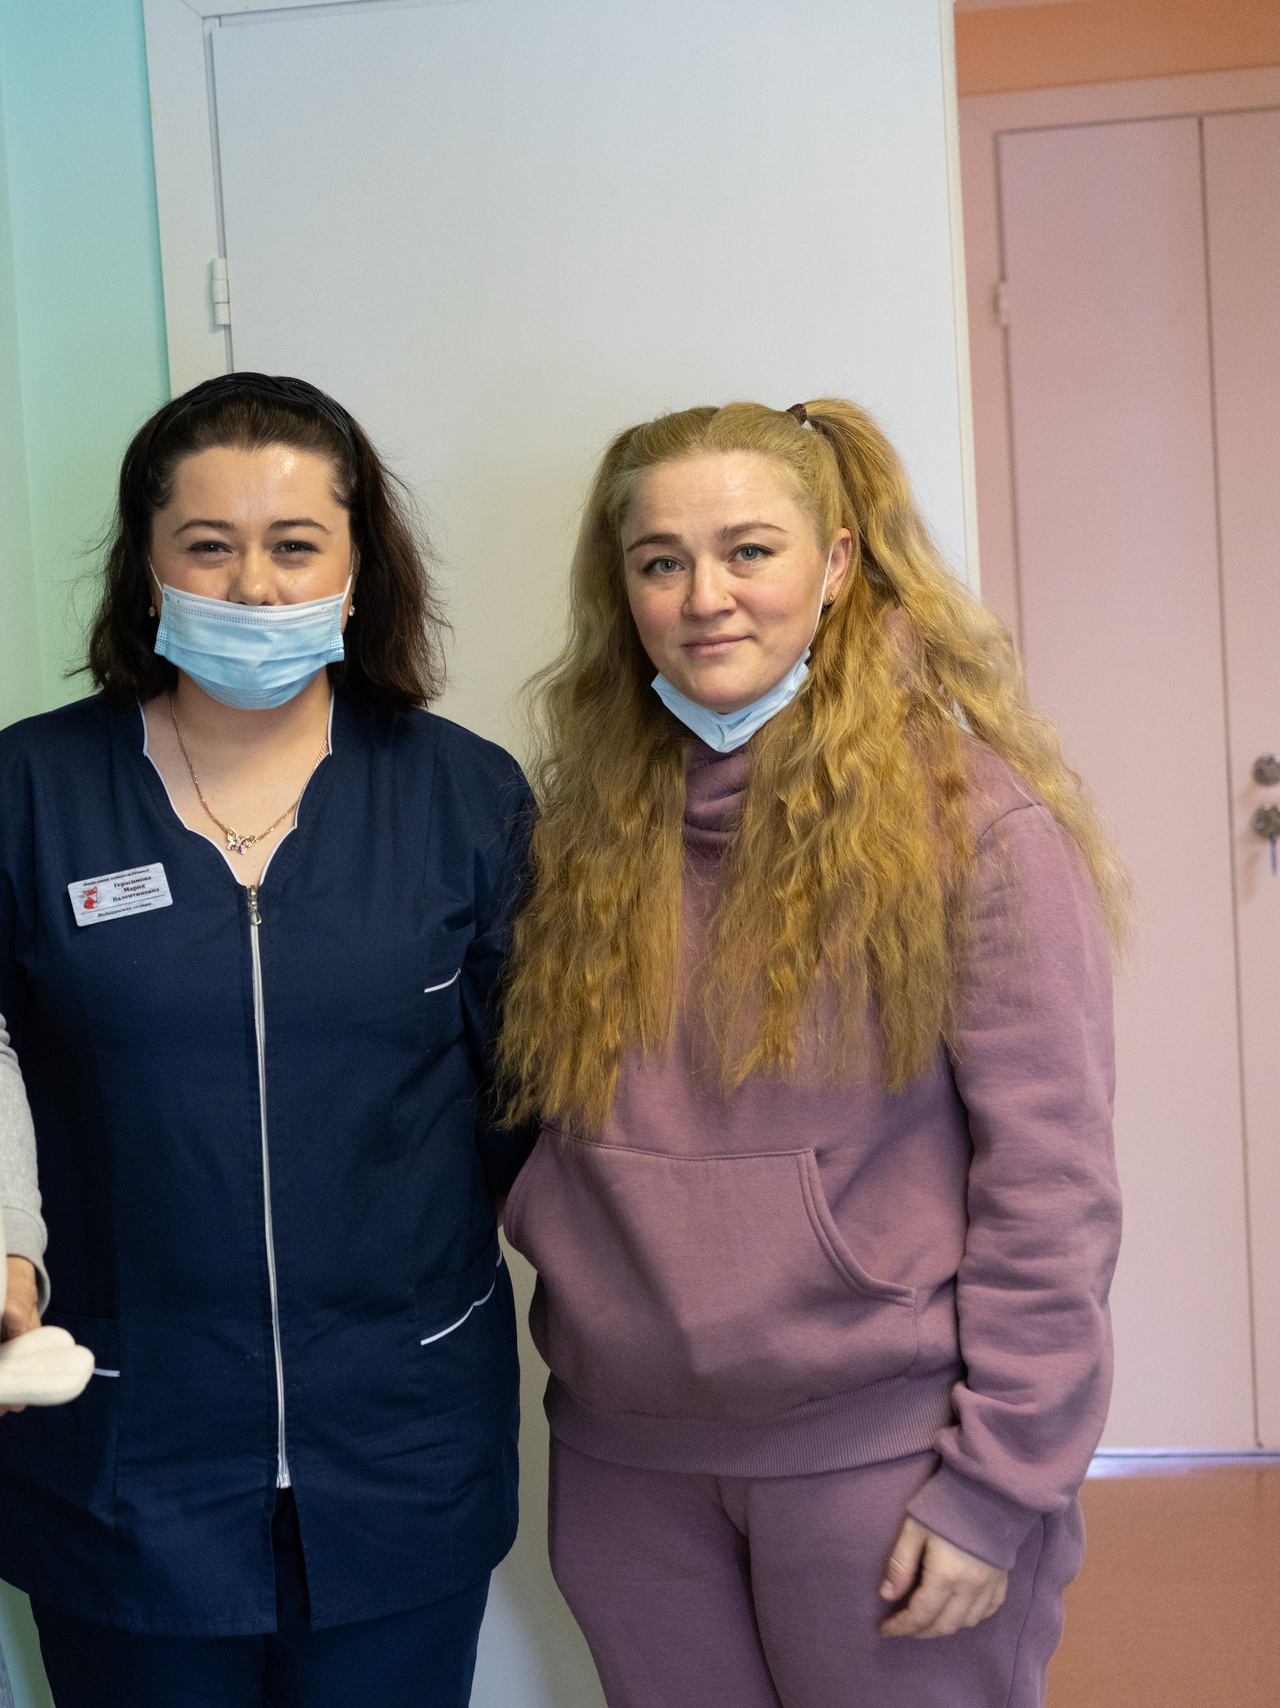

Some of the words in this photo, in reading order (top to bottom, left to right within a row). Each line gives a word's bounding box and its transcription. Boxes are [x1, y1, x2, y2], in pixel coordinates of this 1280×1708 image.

[113, 875, 152, 888] Герасимова
[112, 887, 160, 902] Валентиновна
[123, 884, 146, 893] Мария
